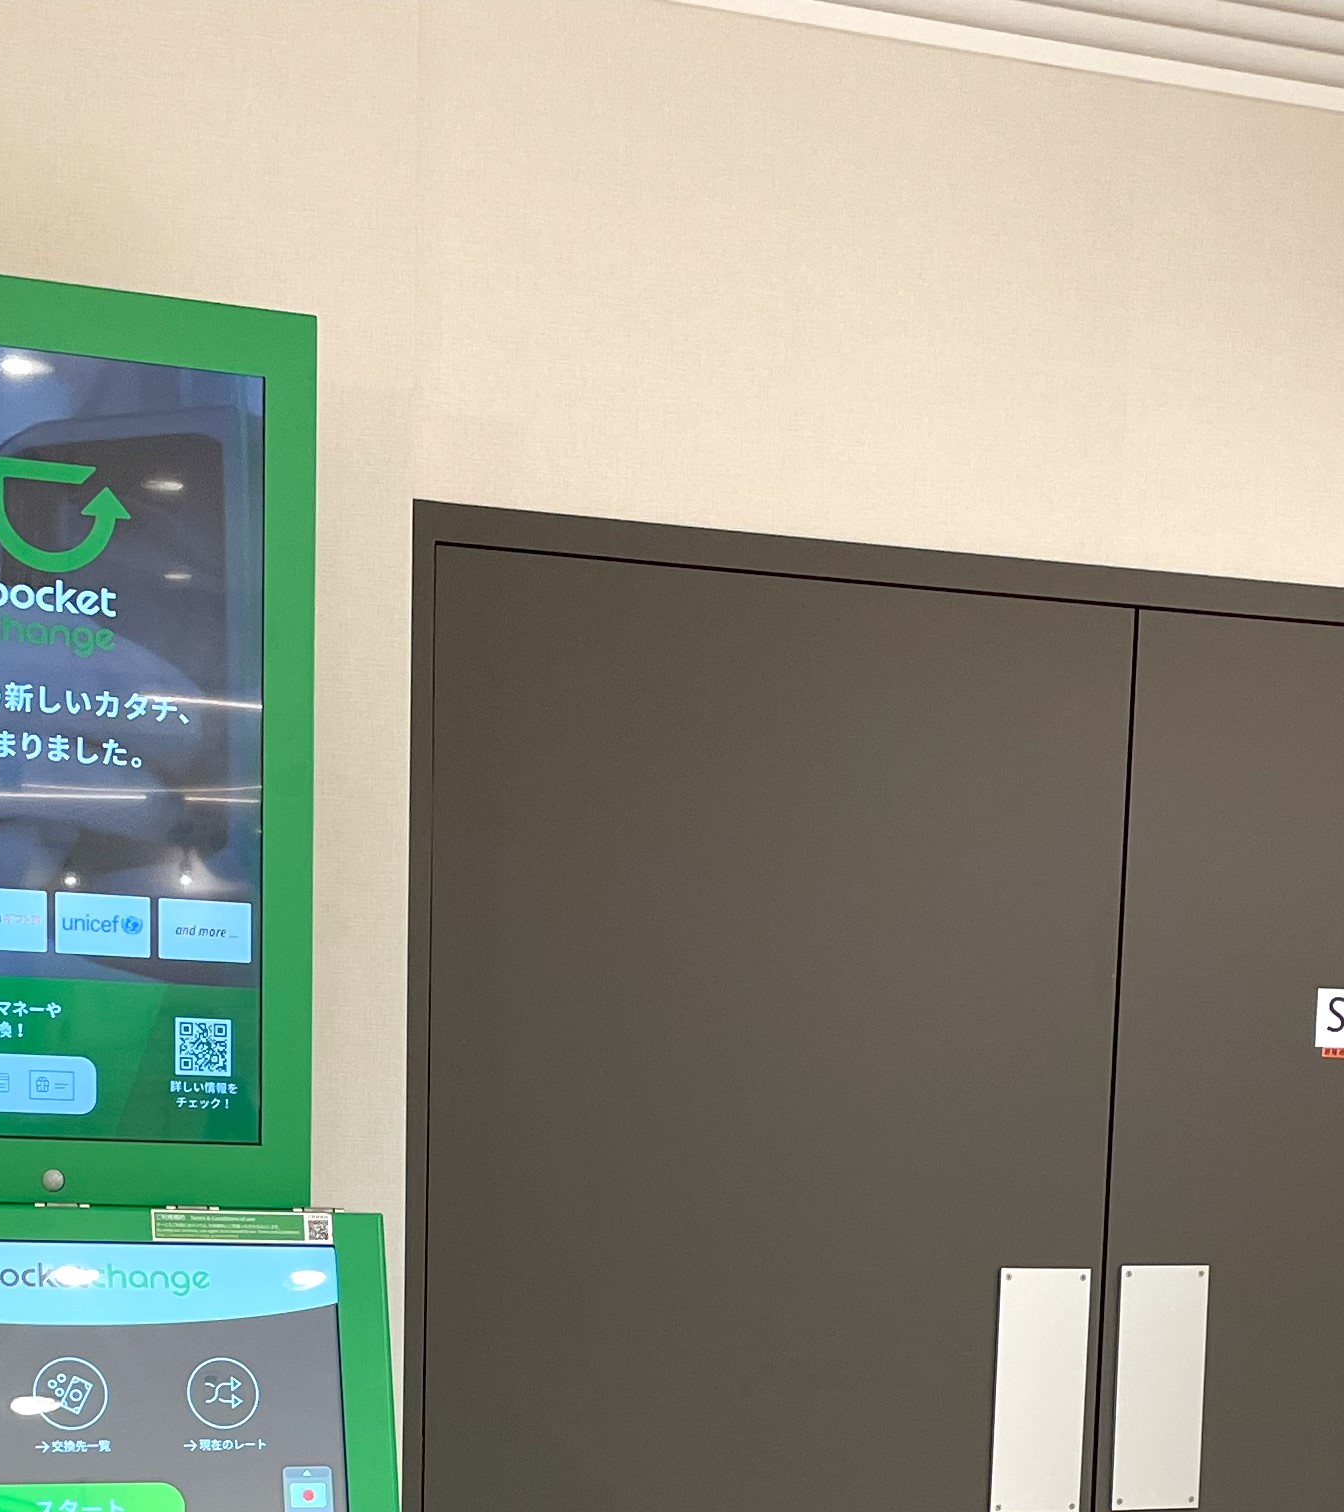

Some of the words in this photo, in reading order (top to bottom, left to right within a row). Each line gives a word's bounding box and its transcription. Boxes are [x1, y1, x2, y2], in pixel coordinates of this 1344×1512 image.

[62, 914, 119, 934] unicef
[175, 925, 195, 937] and
[199, 926, 226, 938] more
[170, 1080, 238, 1095] 詳しい情報を
[176, 1096, 230, 1110] チェック！
[51, 1440, 111, 1453] 交換先一覧
[199, 1438, 267, 1452] 現在のレート
